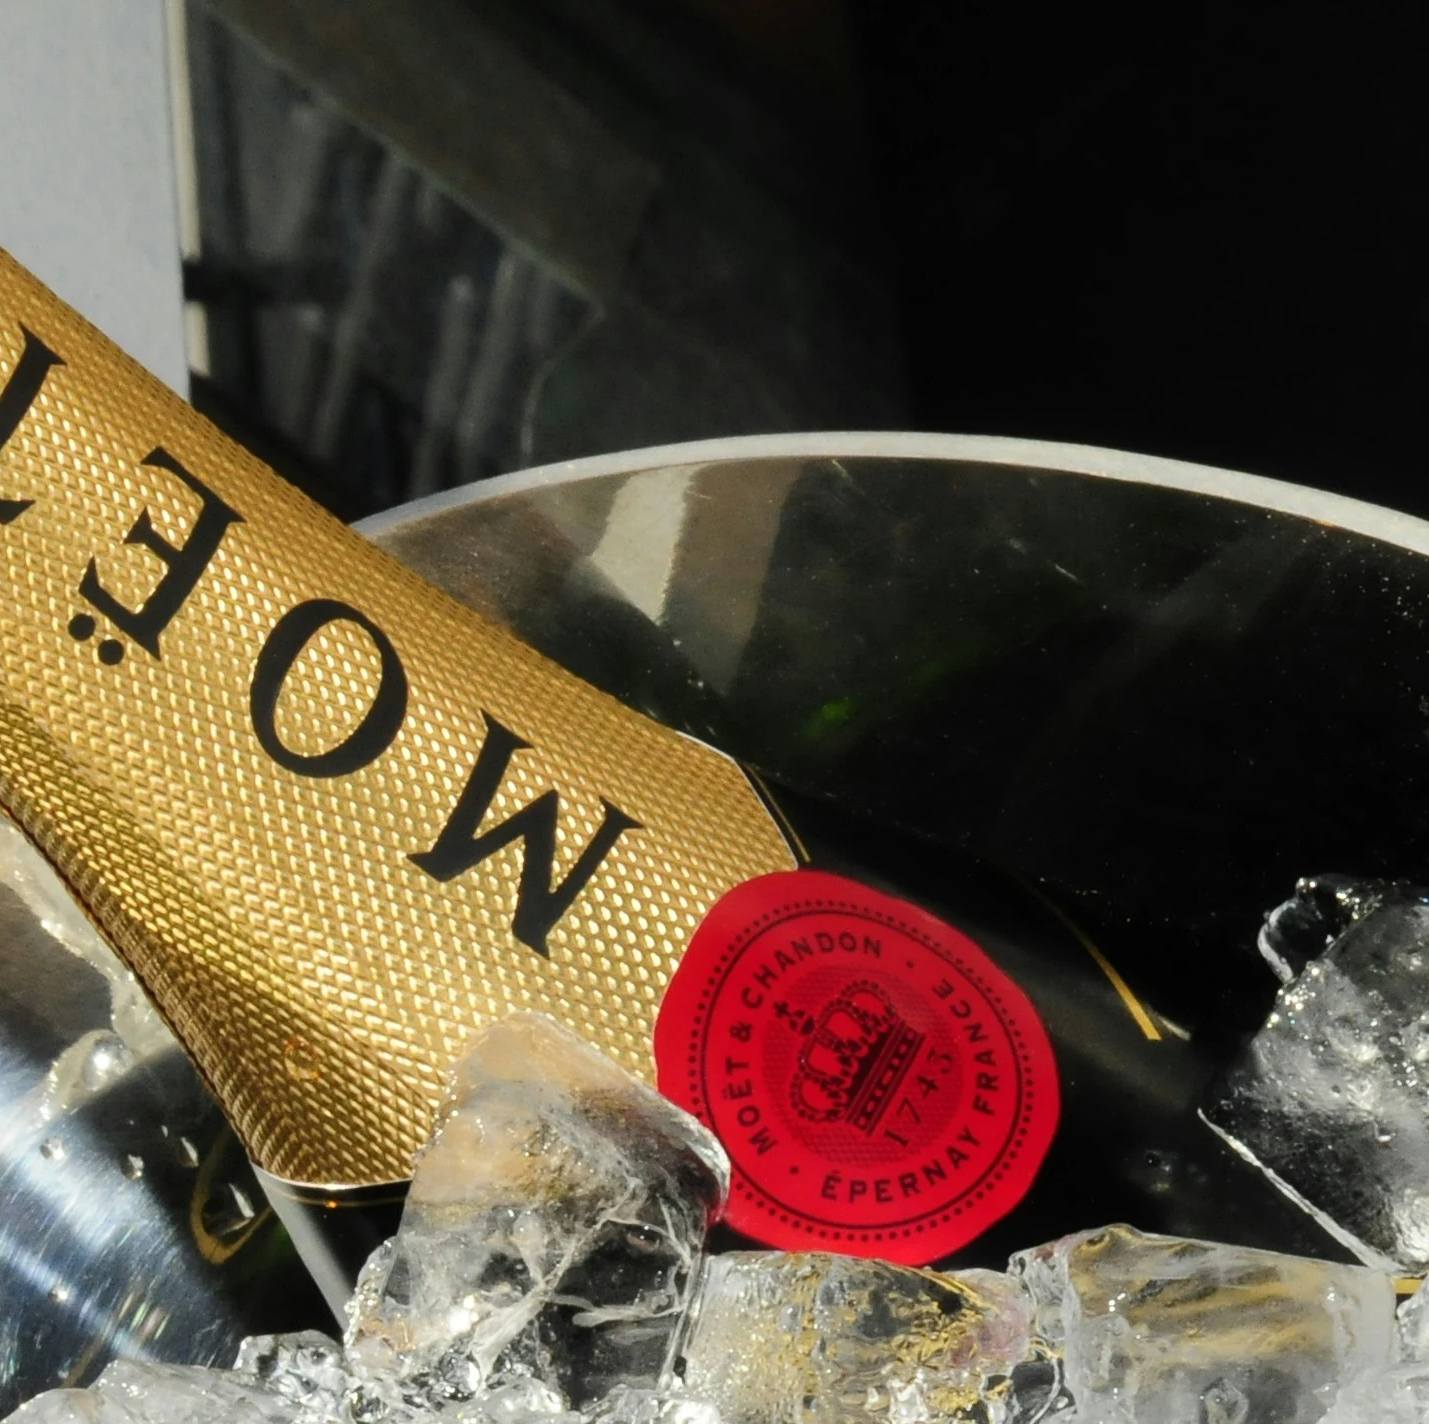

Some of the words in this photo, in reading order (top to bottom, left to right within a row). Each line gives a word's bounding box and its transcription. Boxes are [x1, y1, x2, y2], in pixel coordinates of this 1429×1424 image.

[745, 932, 882, 1009] CHANDON
[731, 1022, 753, 1042] &
[726, 1057, 778, 1156] MOËT
[822, 1128, 981, 1203] ÉPERNAY
[934, 979, 999, 1115] FRANCE
[886, 1052, 953, 1148] 1743
